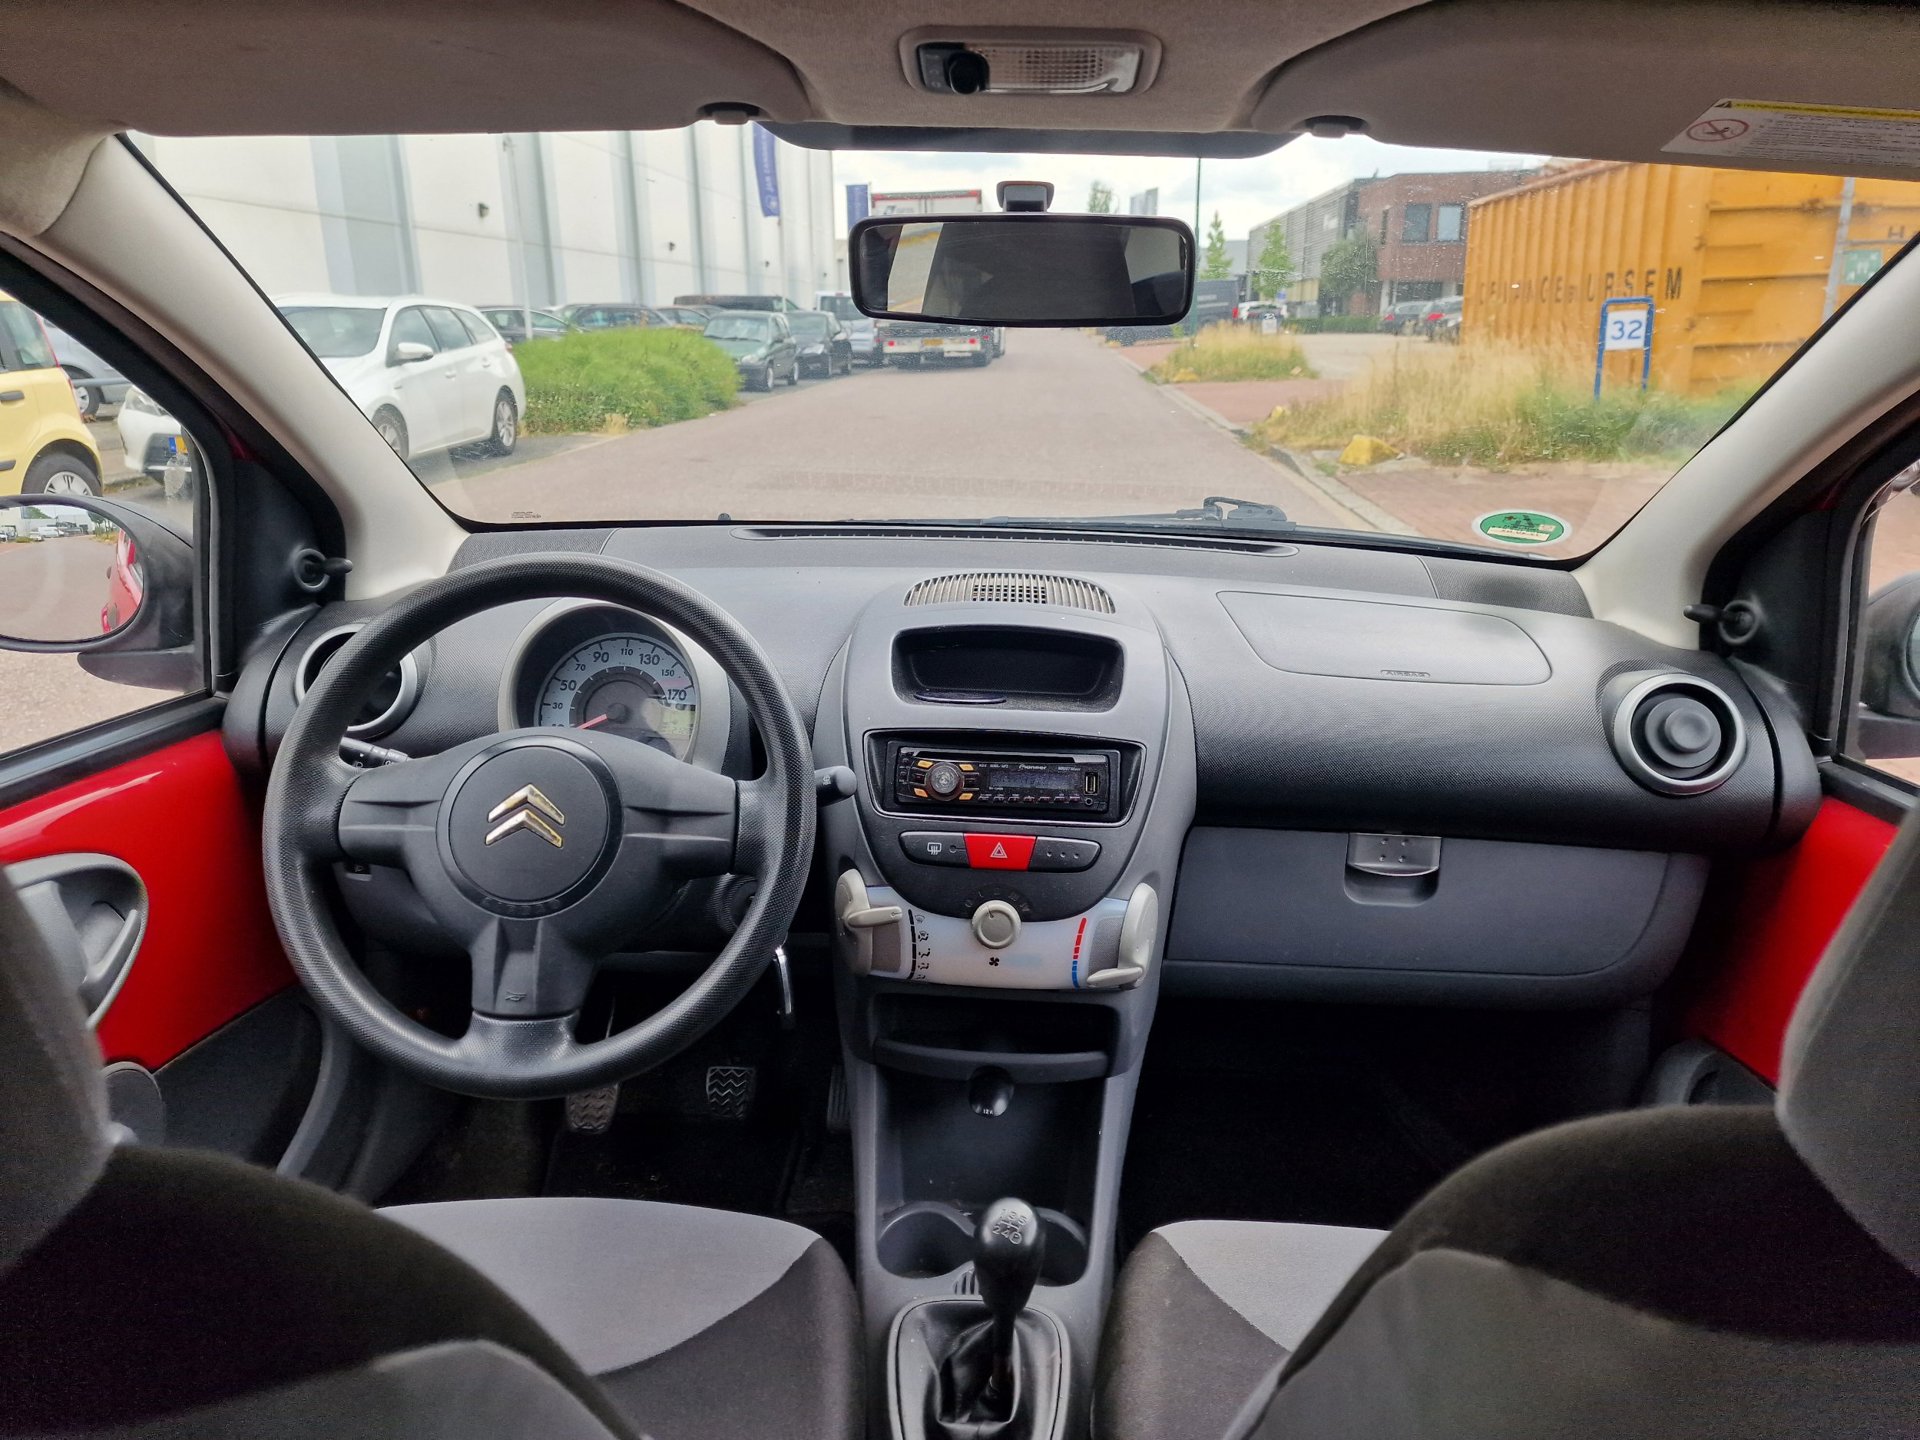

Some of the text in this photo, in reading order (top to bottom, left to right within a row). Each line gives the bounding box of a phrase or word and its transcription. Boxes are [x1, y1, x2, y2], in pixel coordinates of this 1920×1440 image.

[1611, 320, 1643, 341] 32
[593, 652, 610, 663] 90
[621, 648, 633, 656] 110
[639, 654, 661, 665] 130
[574, 663, 586, 671] 70
[662, 669, 675, 677] 150
[560, 680, 577, 691] 50
[667, 689, 687, 701] 170
[992, 1223, 1001, 1234] 2
[1001, 1229, 1009, 1239] 4
